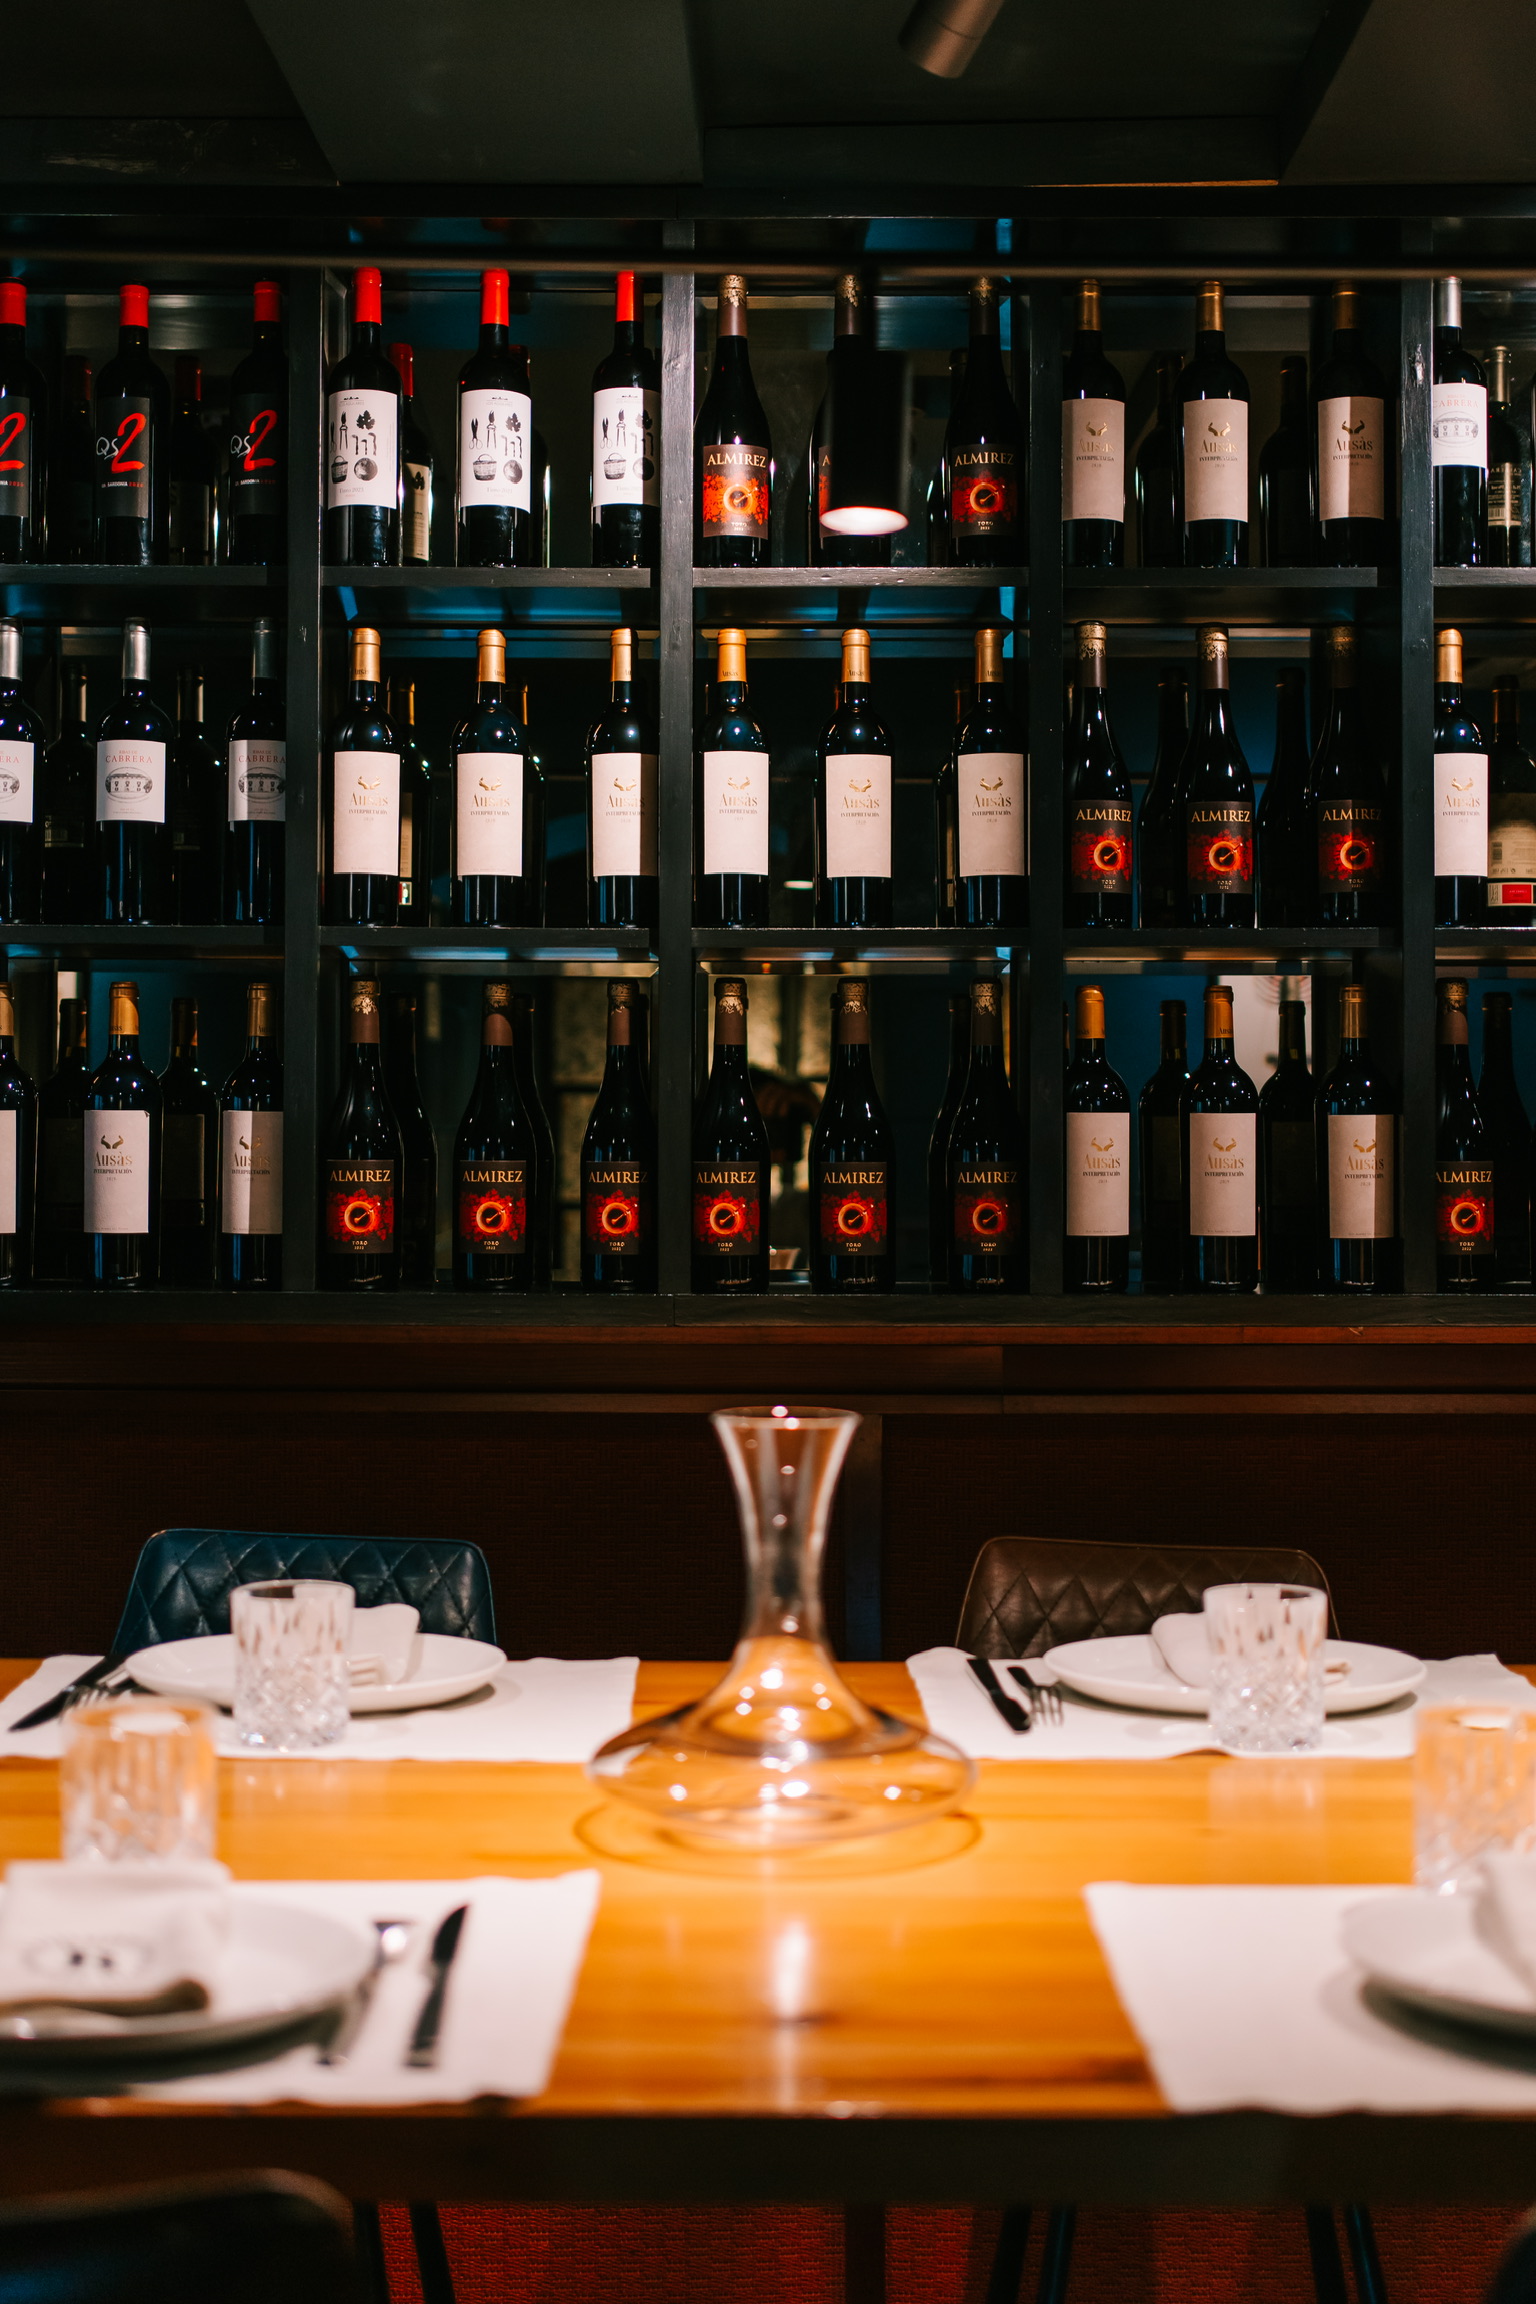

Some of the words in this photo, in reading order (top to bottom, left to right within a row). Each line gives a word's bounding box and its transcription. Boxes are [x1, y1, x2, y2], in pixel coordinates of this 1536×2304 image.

[707, 452, 767, 468] ALMIREZ
[954, 451, 1015, 467] ALMIREZ
[105, 755, 153, 764] CABRERA
[238, 755, 286, 764] CABRERA
[1076, 808, 1132, 823] ALMIREZ
[1191, 809, 1251, 823] ALMIREZ
[1322, 808, 1382, 822] ALMIREZ
[94, 1151, 133, 1167] Ausàs
[1083, 1153, 1121, 1169] Ausàs
[1206, 1153, 1245, 1169] Ausàs
[329, 1169, 391, 1182] ALMIREZ
[462, 1170, 523, 1183] ALMIREZ
[588, 1171, 648, 1184] ALMIREZ
[696, 1171, 756, 1184] ALMIREZ
[823, 1172, 884, 1184] ALMIREZ
[957, 1172, 1017, 1184] ALMIREZ
